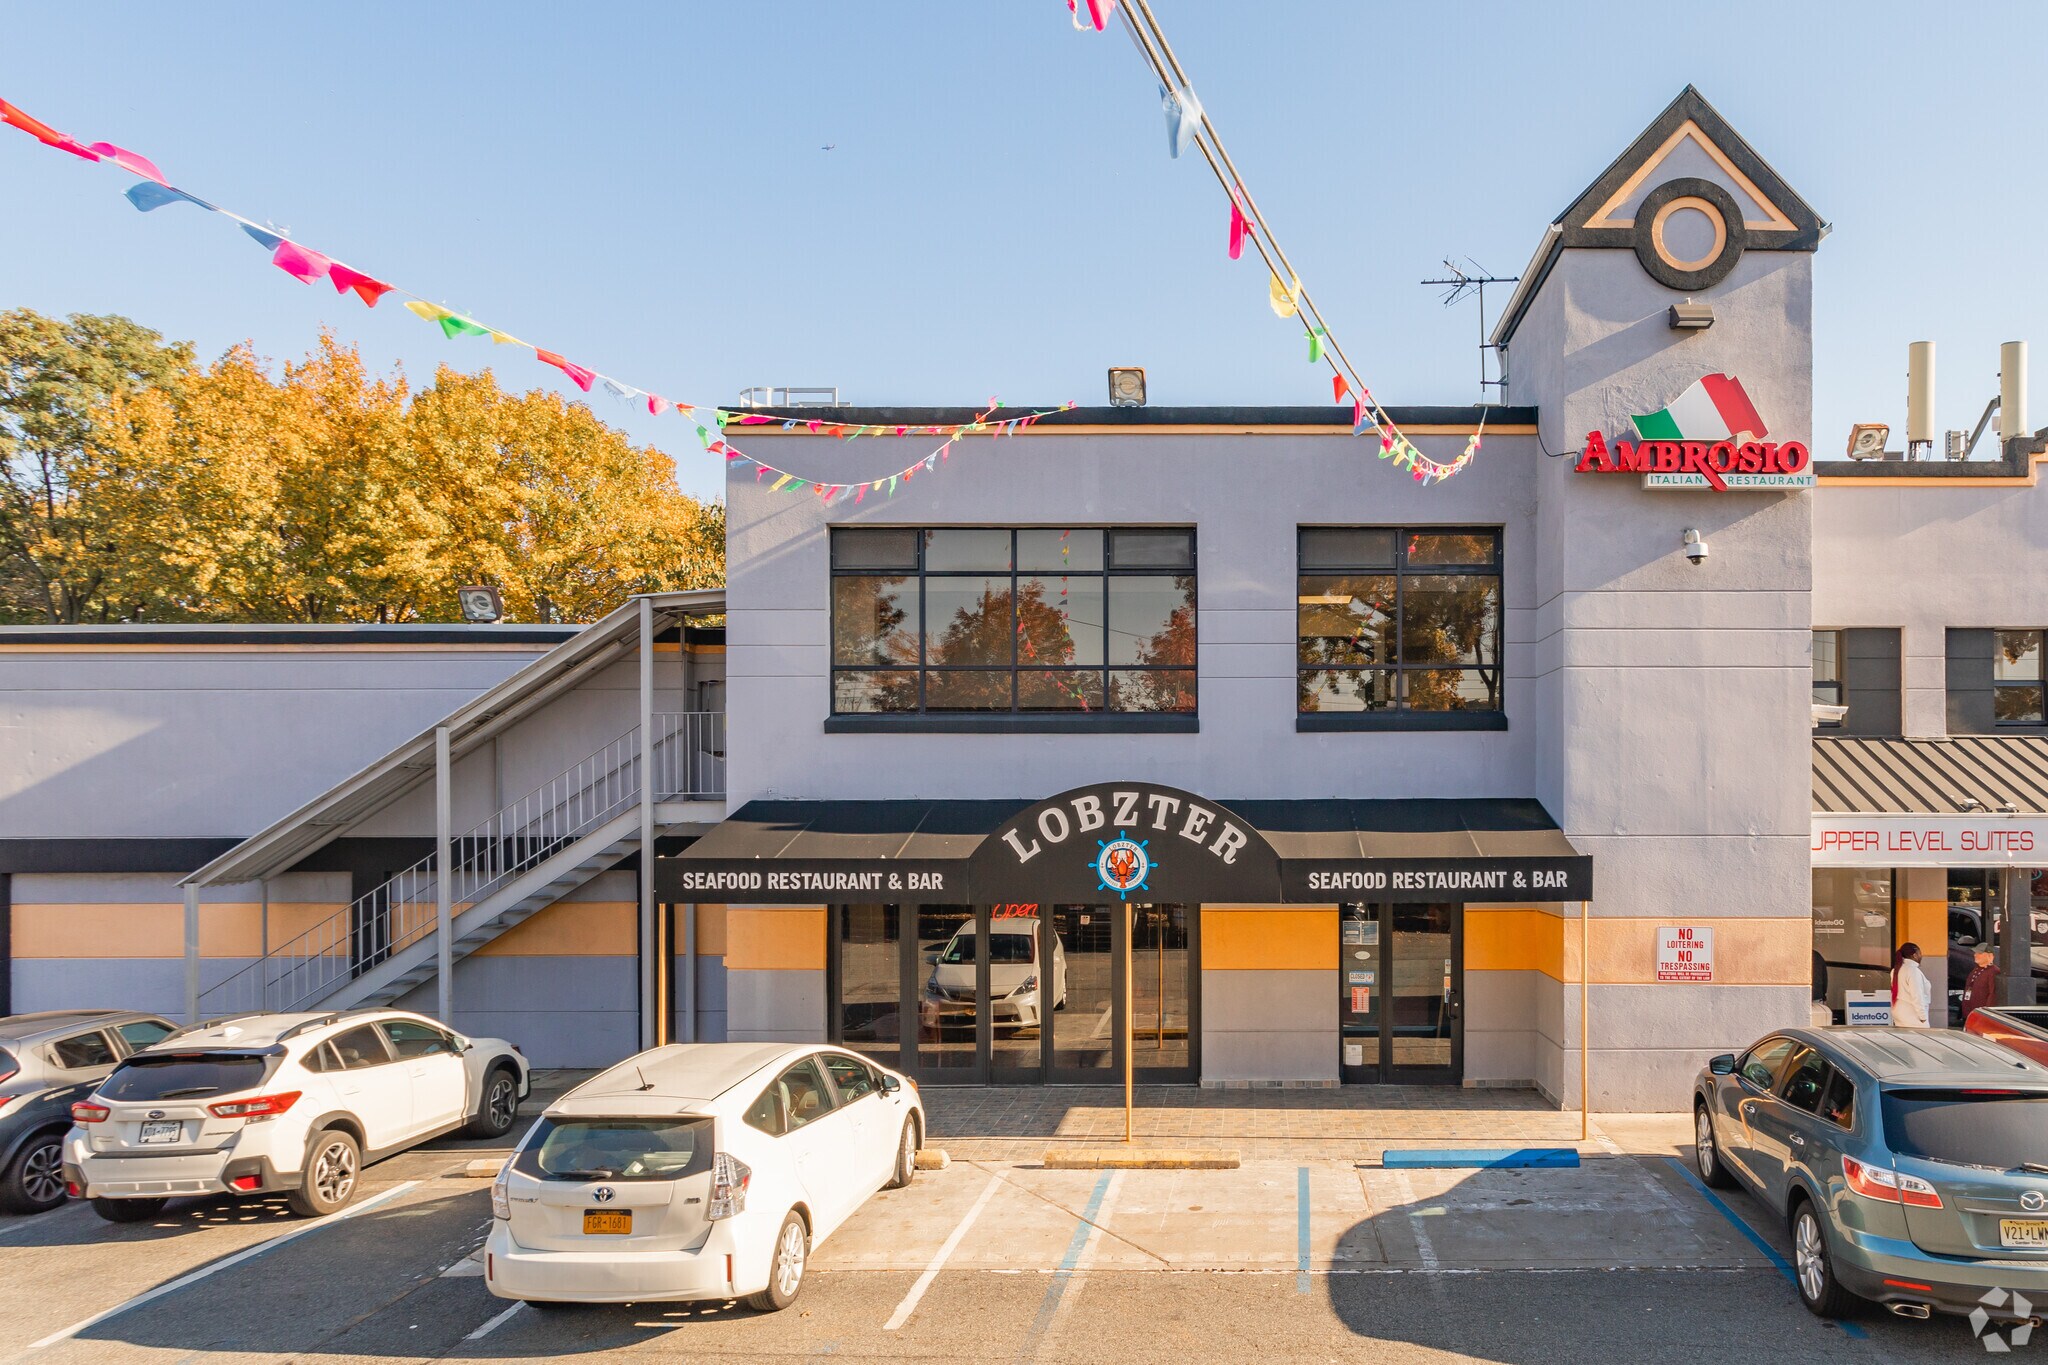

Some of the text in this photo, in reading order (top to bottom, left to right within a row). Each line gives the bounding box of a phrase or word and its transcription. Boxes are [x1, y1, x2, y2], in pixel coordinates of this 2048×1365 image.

[1574, 430, 1809, 492] AMBROSIO
[1650, 475, 1812, 485] ITALIAN RESTAURANT
[1002, 791, 1248, 865] LOBZTER
[1888, 831, 1952, 851] LEVEL
[1961, 831, 2034, 851] SUITES
[683, 872, 944, 890] SEAFOOD RESTAURANT & BAR
[1308, 871, 1568, 889] SEAFOOD RESTAURANT & BAR
[1678, 928, 1693, 940] NO
[1667, 941, 1704, 949] LOITERING
[1678, 950, 1693, 962] NO
[1660, 962, 1710, 971] TRESPASSING
[1851, 1012, 1889, 1020] IdentoGO
